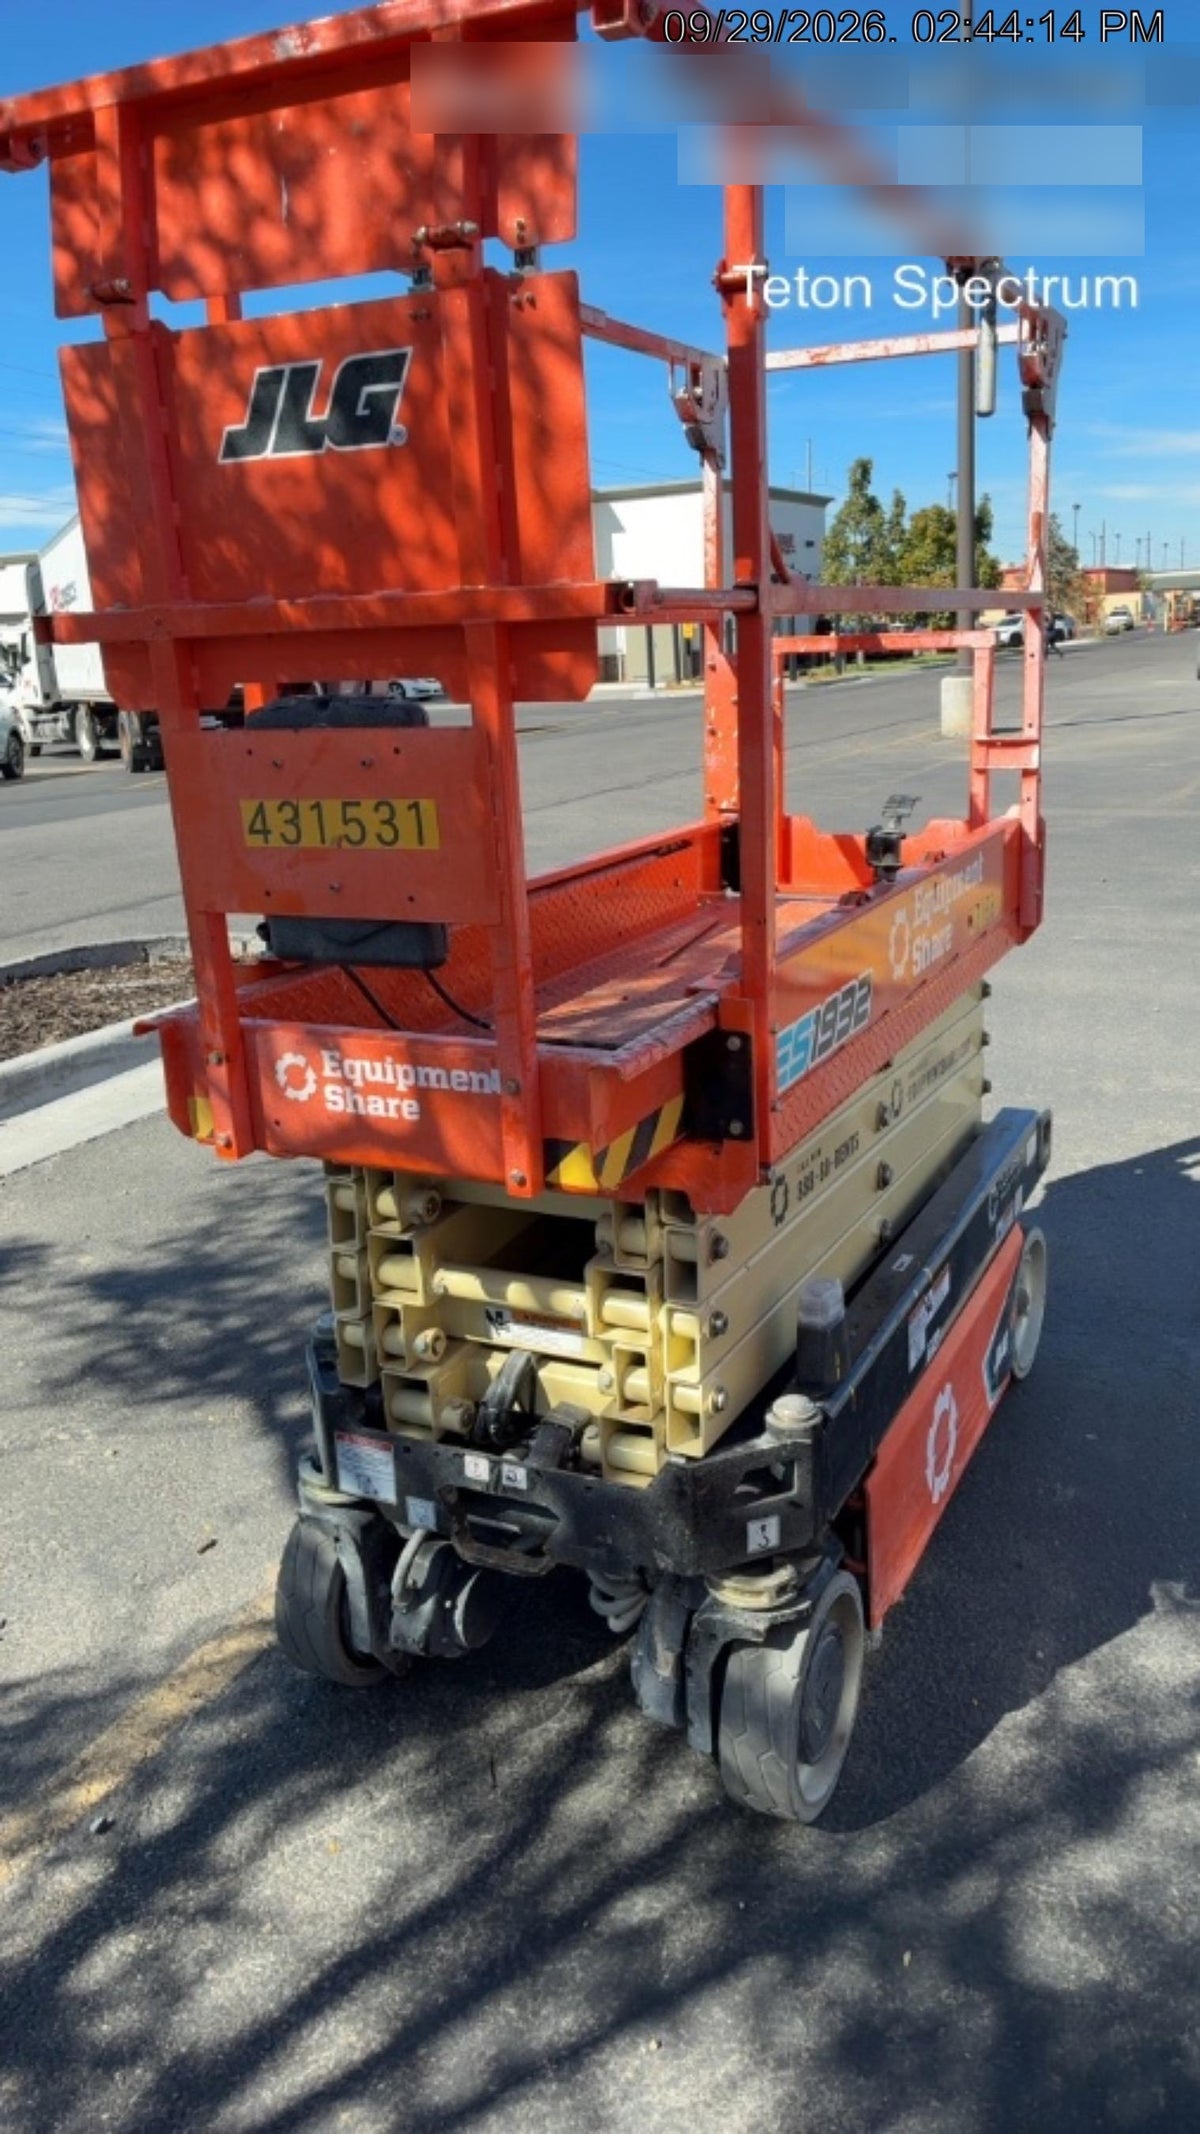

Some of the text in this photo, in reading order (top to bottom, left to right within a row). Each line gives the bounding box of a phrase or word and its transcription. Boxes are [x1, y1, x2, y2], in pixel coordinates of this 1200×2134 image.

[217, 345, 414, 465] JLG
[247, 800, 426, 848] 431531
[776, 967, 873, 1095] ES1932
[322, 1083, 421, 1121] Share
